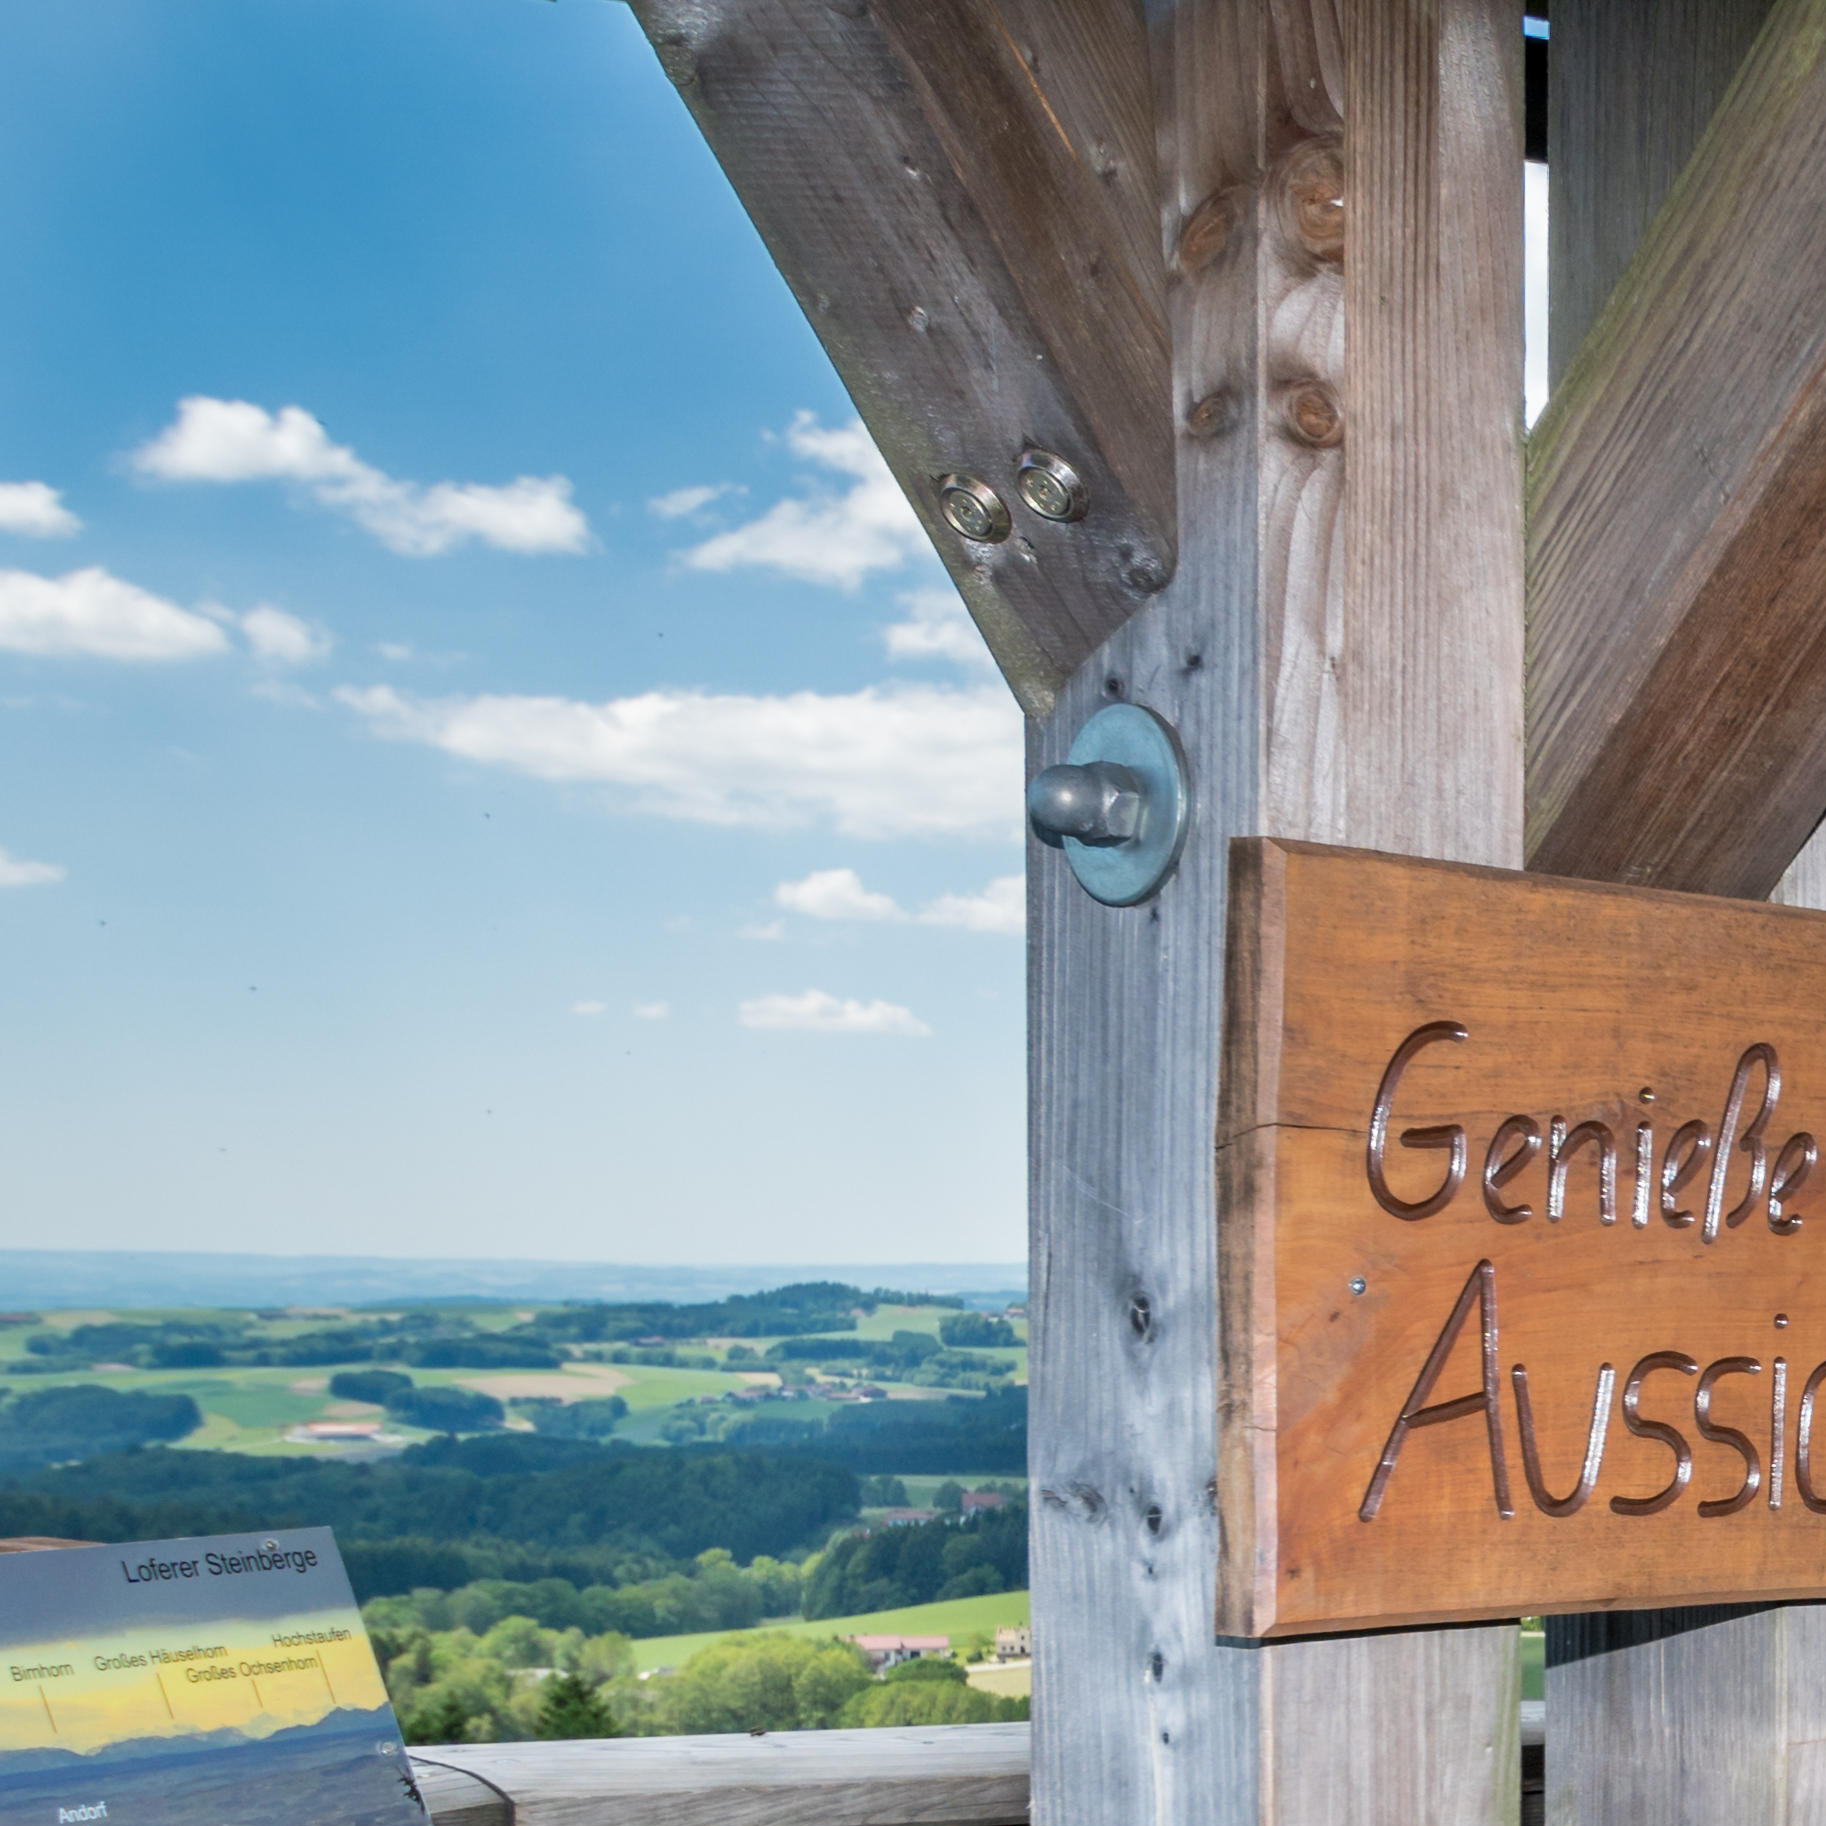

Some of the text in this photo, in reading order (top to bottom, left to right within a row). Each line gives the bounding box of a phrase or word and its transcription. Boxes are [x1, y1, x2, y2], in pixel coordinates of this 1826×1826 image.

[1366, 1020, 1818, 1244] Genieße
[121, 1548, 319, 1584] Loferer Steinberge
[271, 1626, 352, 1649] Hochstaufen
[94, 1644, 229, 1672] Großes Häuselhorn
[186, 1654, 319, 1684] Großes Ochsenhorn
[58, 1800, 108, 1824] Andorf
